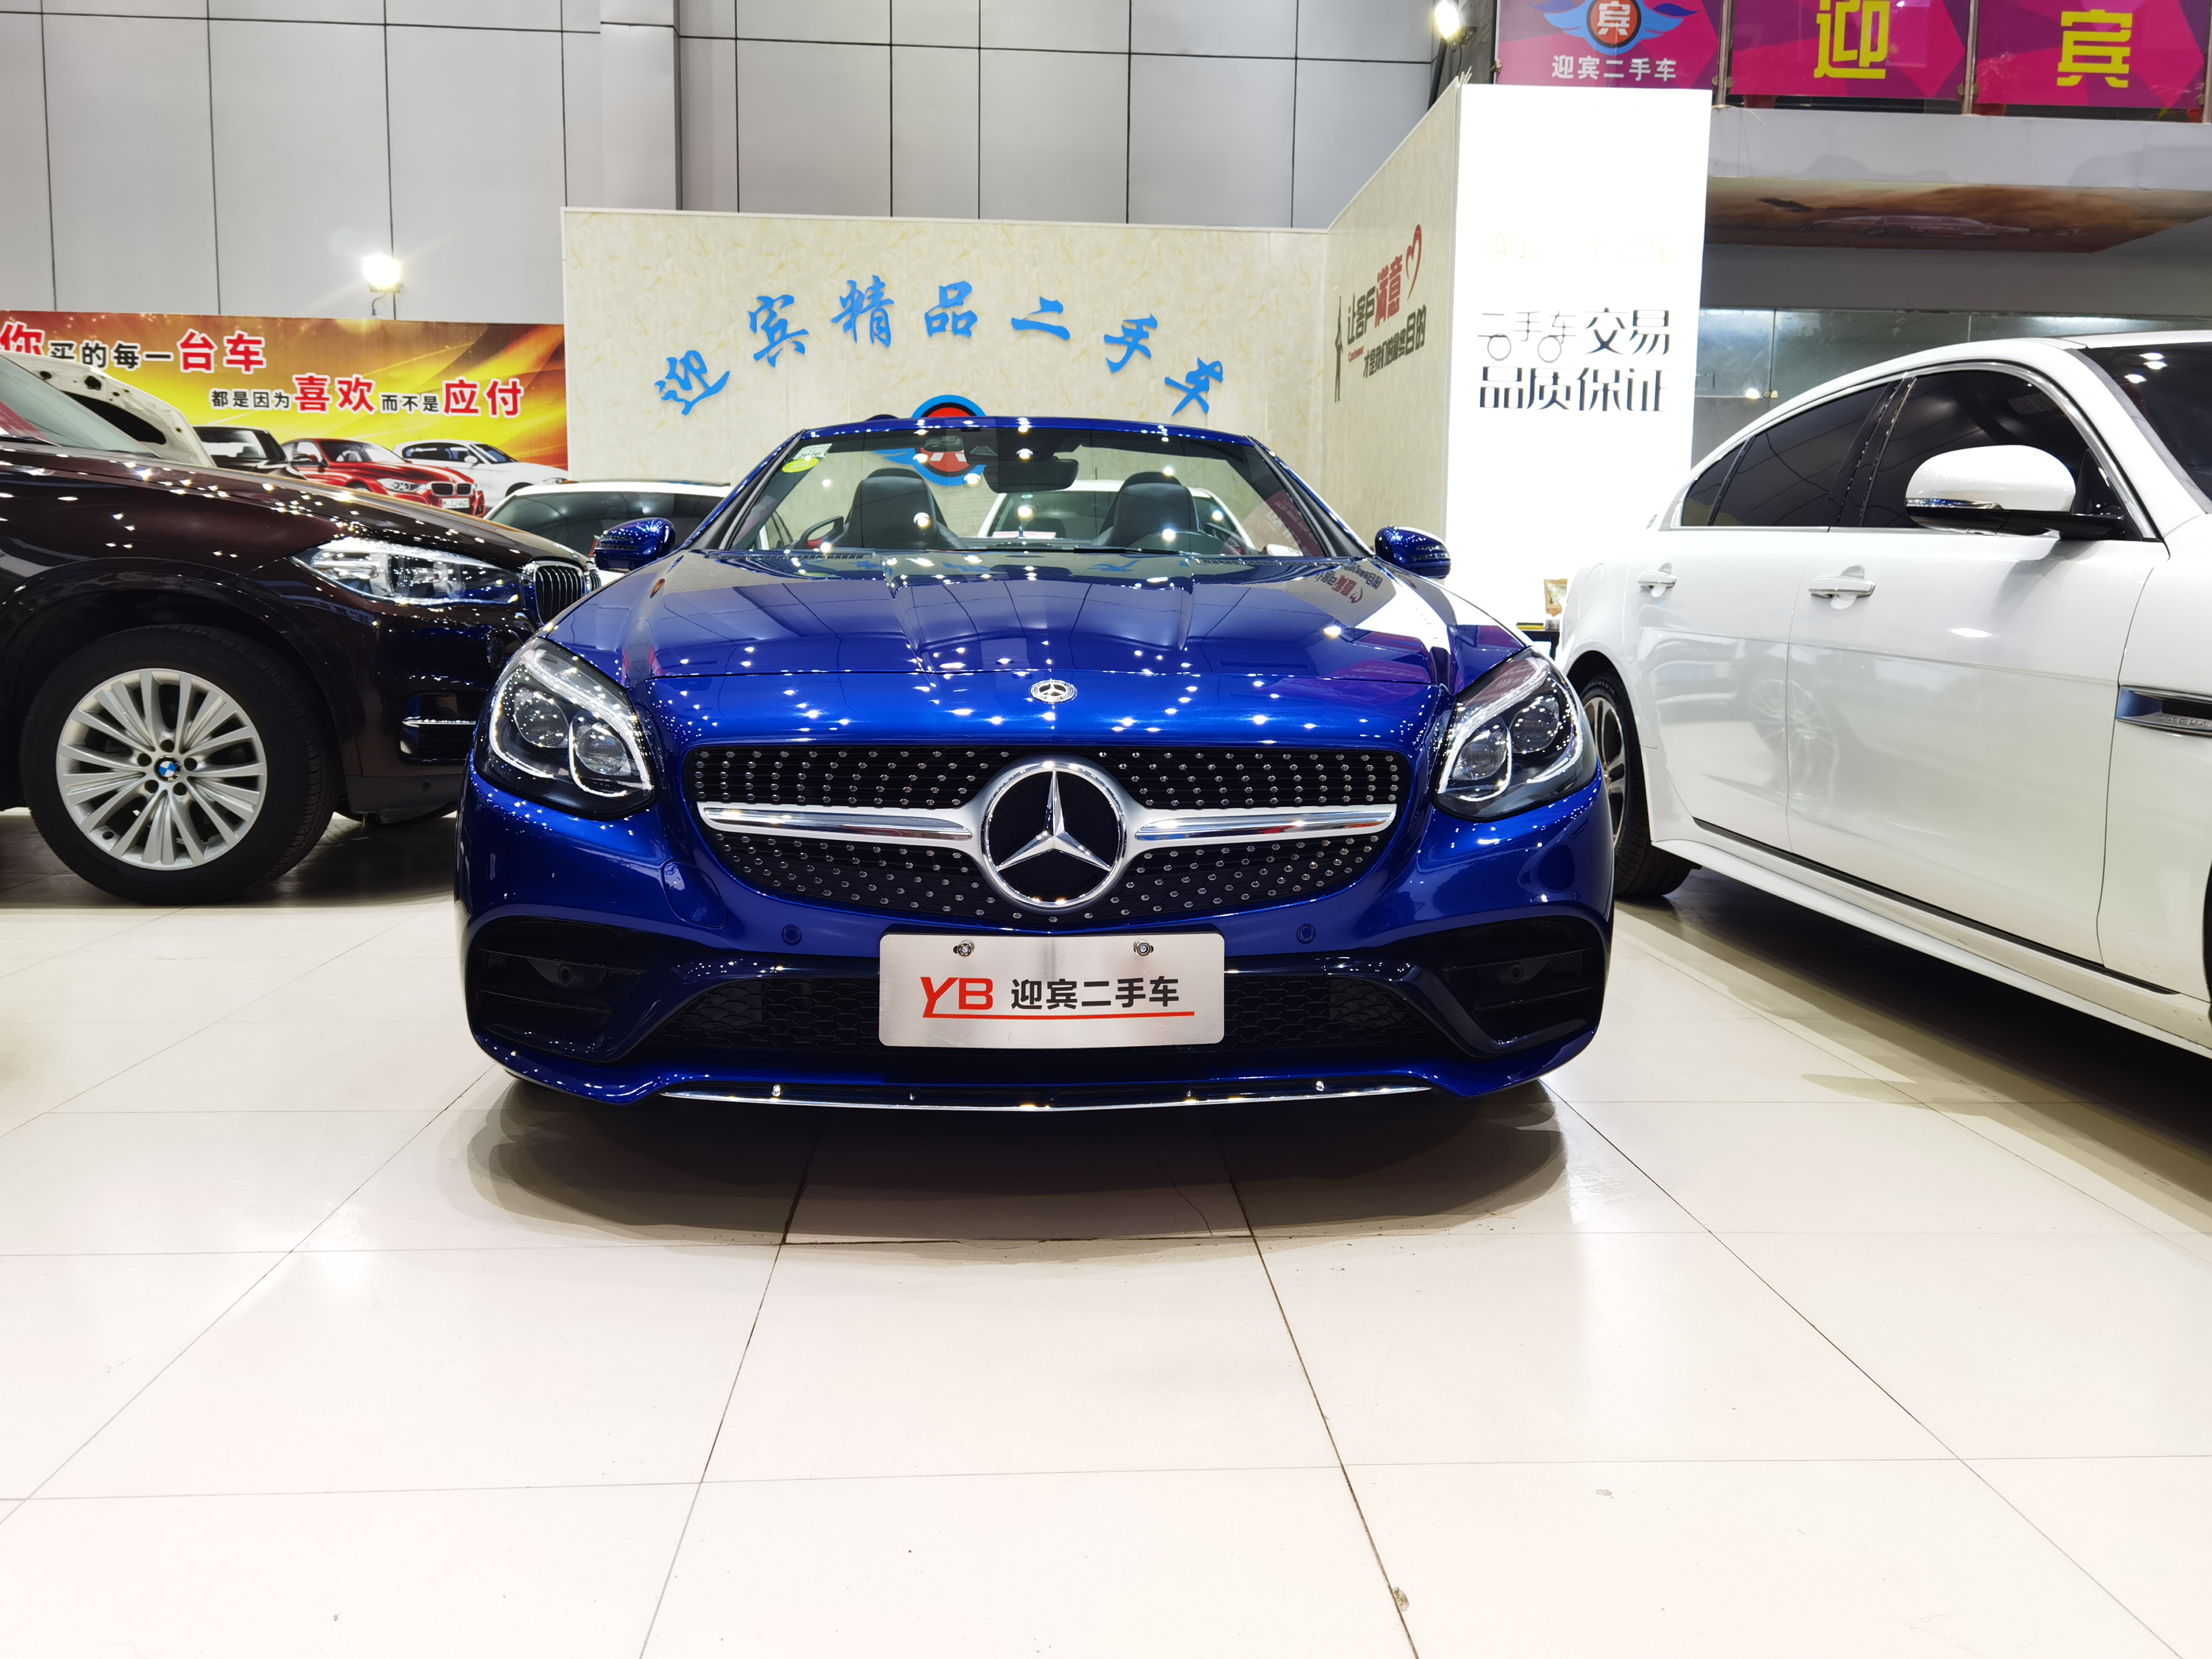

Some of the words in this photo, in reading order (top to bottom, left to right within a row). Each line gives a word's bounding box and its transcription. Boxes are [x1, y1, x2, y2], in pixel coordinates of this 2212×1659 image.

[1597, 1, 1631, 36] 宾
[1814, 0, 1890, 79] 迎
[1552, 55, 1677, 82] 迎宾二手车
[2057, 9, 2133, 88] 宾
[1347, 254, 1403, 346] 让客户满意
[1478, 307, 1670, 363] 二手车交易
[211, 376, 522, 415] 都是因为喜欢而不是应付
[1479, 366, 1671, 412] 品质保证
[920, 976, 993, 1018] YB
[1011, 976, 1179, 1010] 迎宾二手车
